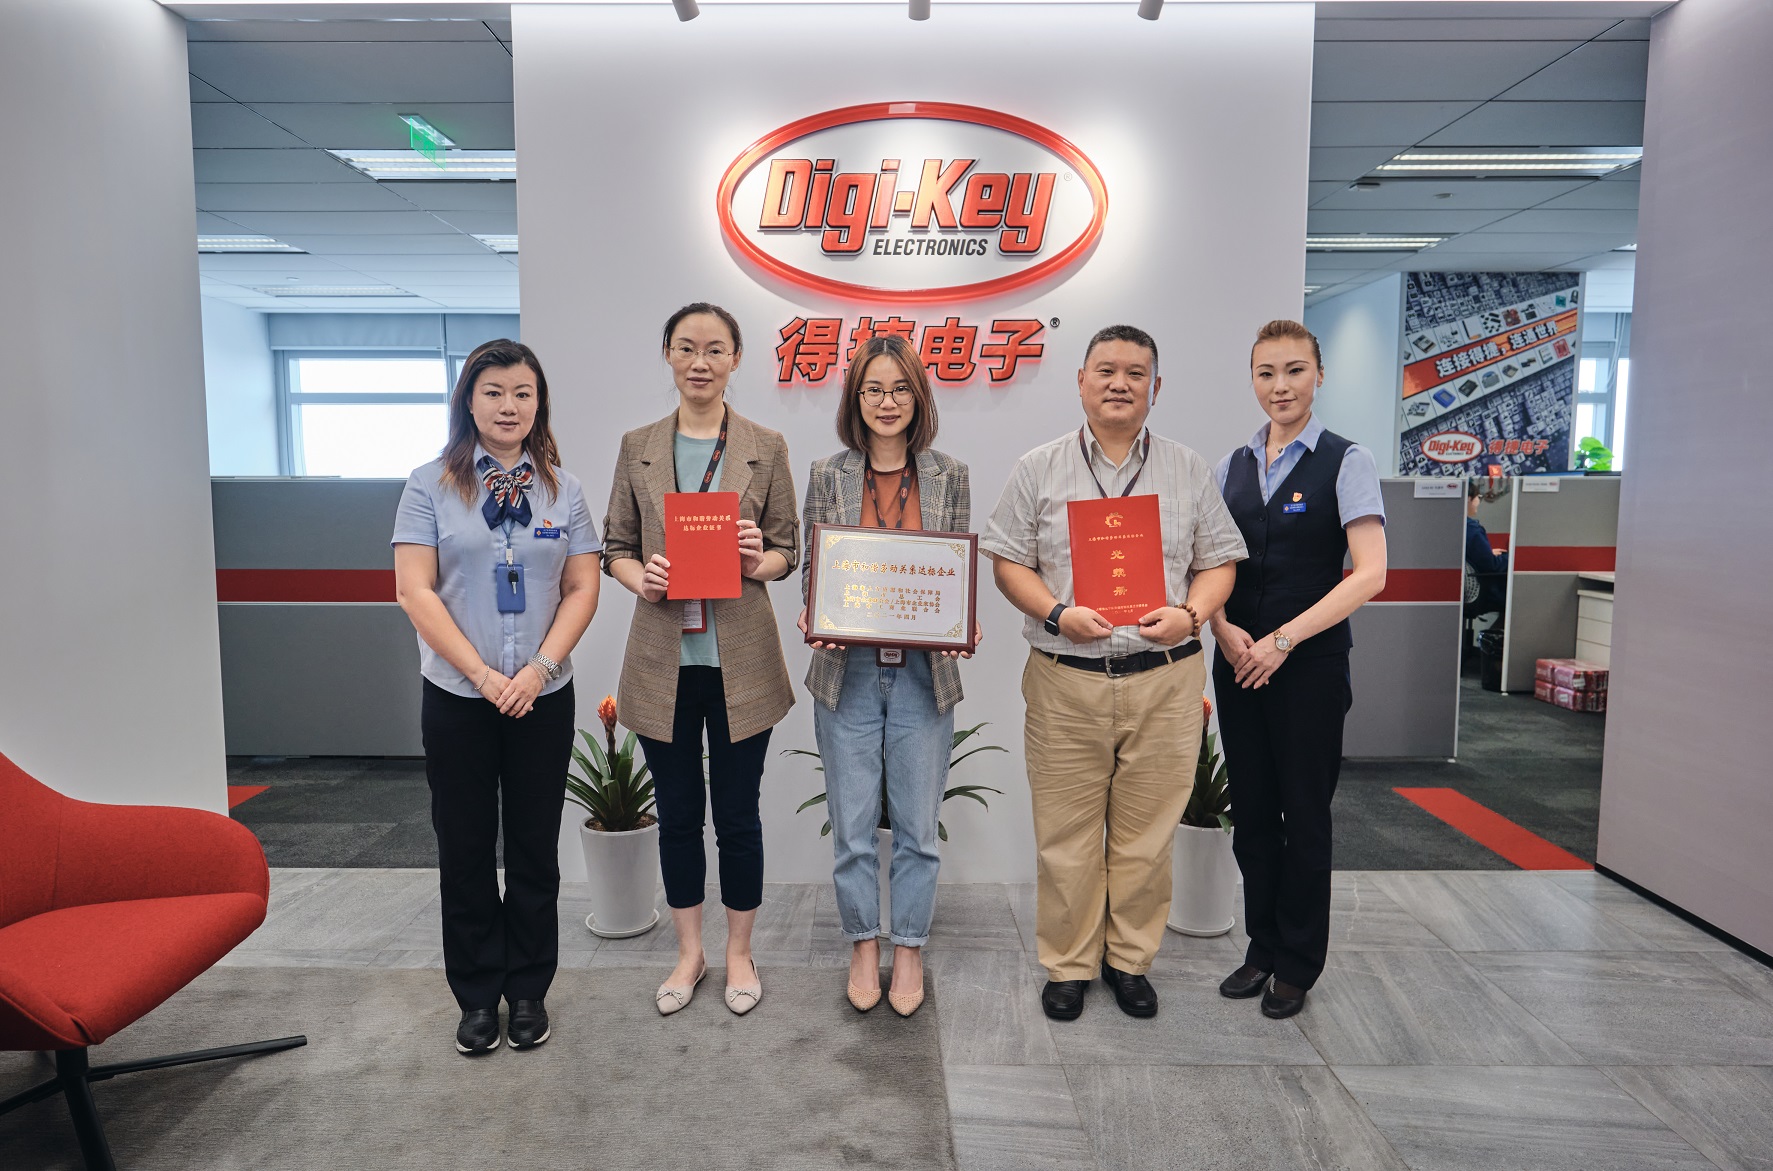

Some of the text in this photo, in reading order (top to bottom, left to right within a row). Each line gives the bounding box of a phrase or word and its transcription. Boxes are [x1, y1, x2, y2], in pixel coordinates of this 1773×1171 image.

[758, 158, 1057, 256] Digi-Key
[873, 238, 989, 256] ELECTRONICS
[1428, 440, 1475, 455] Digi-Key
[1488, 439, 1549, 455] 得捷电子
[832, 560, 956, 576] 上海市和谐劳动关系达标企业
